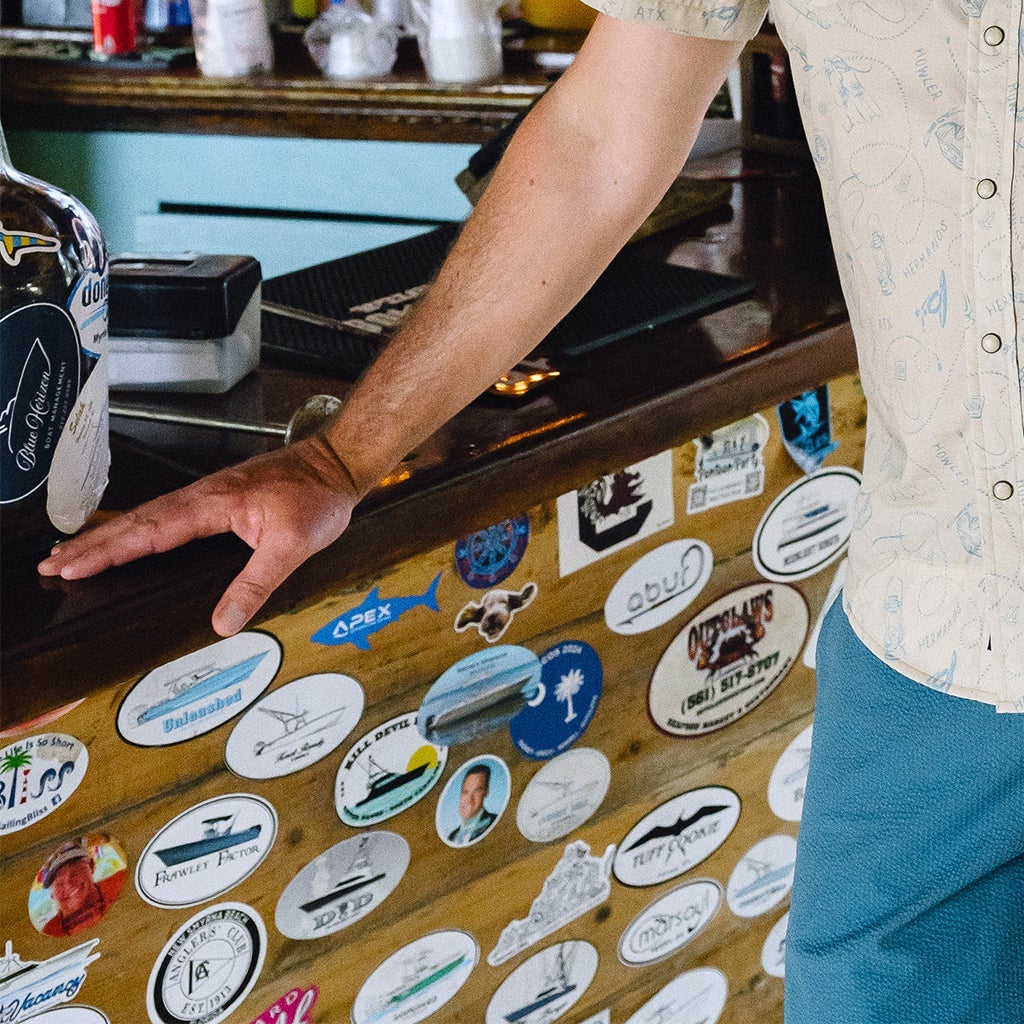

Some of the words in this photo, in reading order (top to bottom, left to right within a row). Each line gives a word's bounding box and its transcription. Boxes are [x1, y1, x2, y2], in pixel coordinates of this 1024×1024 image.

[914, 47, 943, 101] HOWLER
[902, 221, 949, 279] HERMANOS
[25, 370, 51, 431] Horizon
[44, 423, 53, 449] BOAT
[51, 360, 68, 422] MANAGEMENT
[16, 430, 39, 472] Blue
[162, 687, 242, 734] Unleashed
[37, 737, 48, 748] So
[344, 740, 372, 771] KILL
[375, 718, 411, 742] DEVIL
[0, 805, 48, 830] ailingBliss
